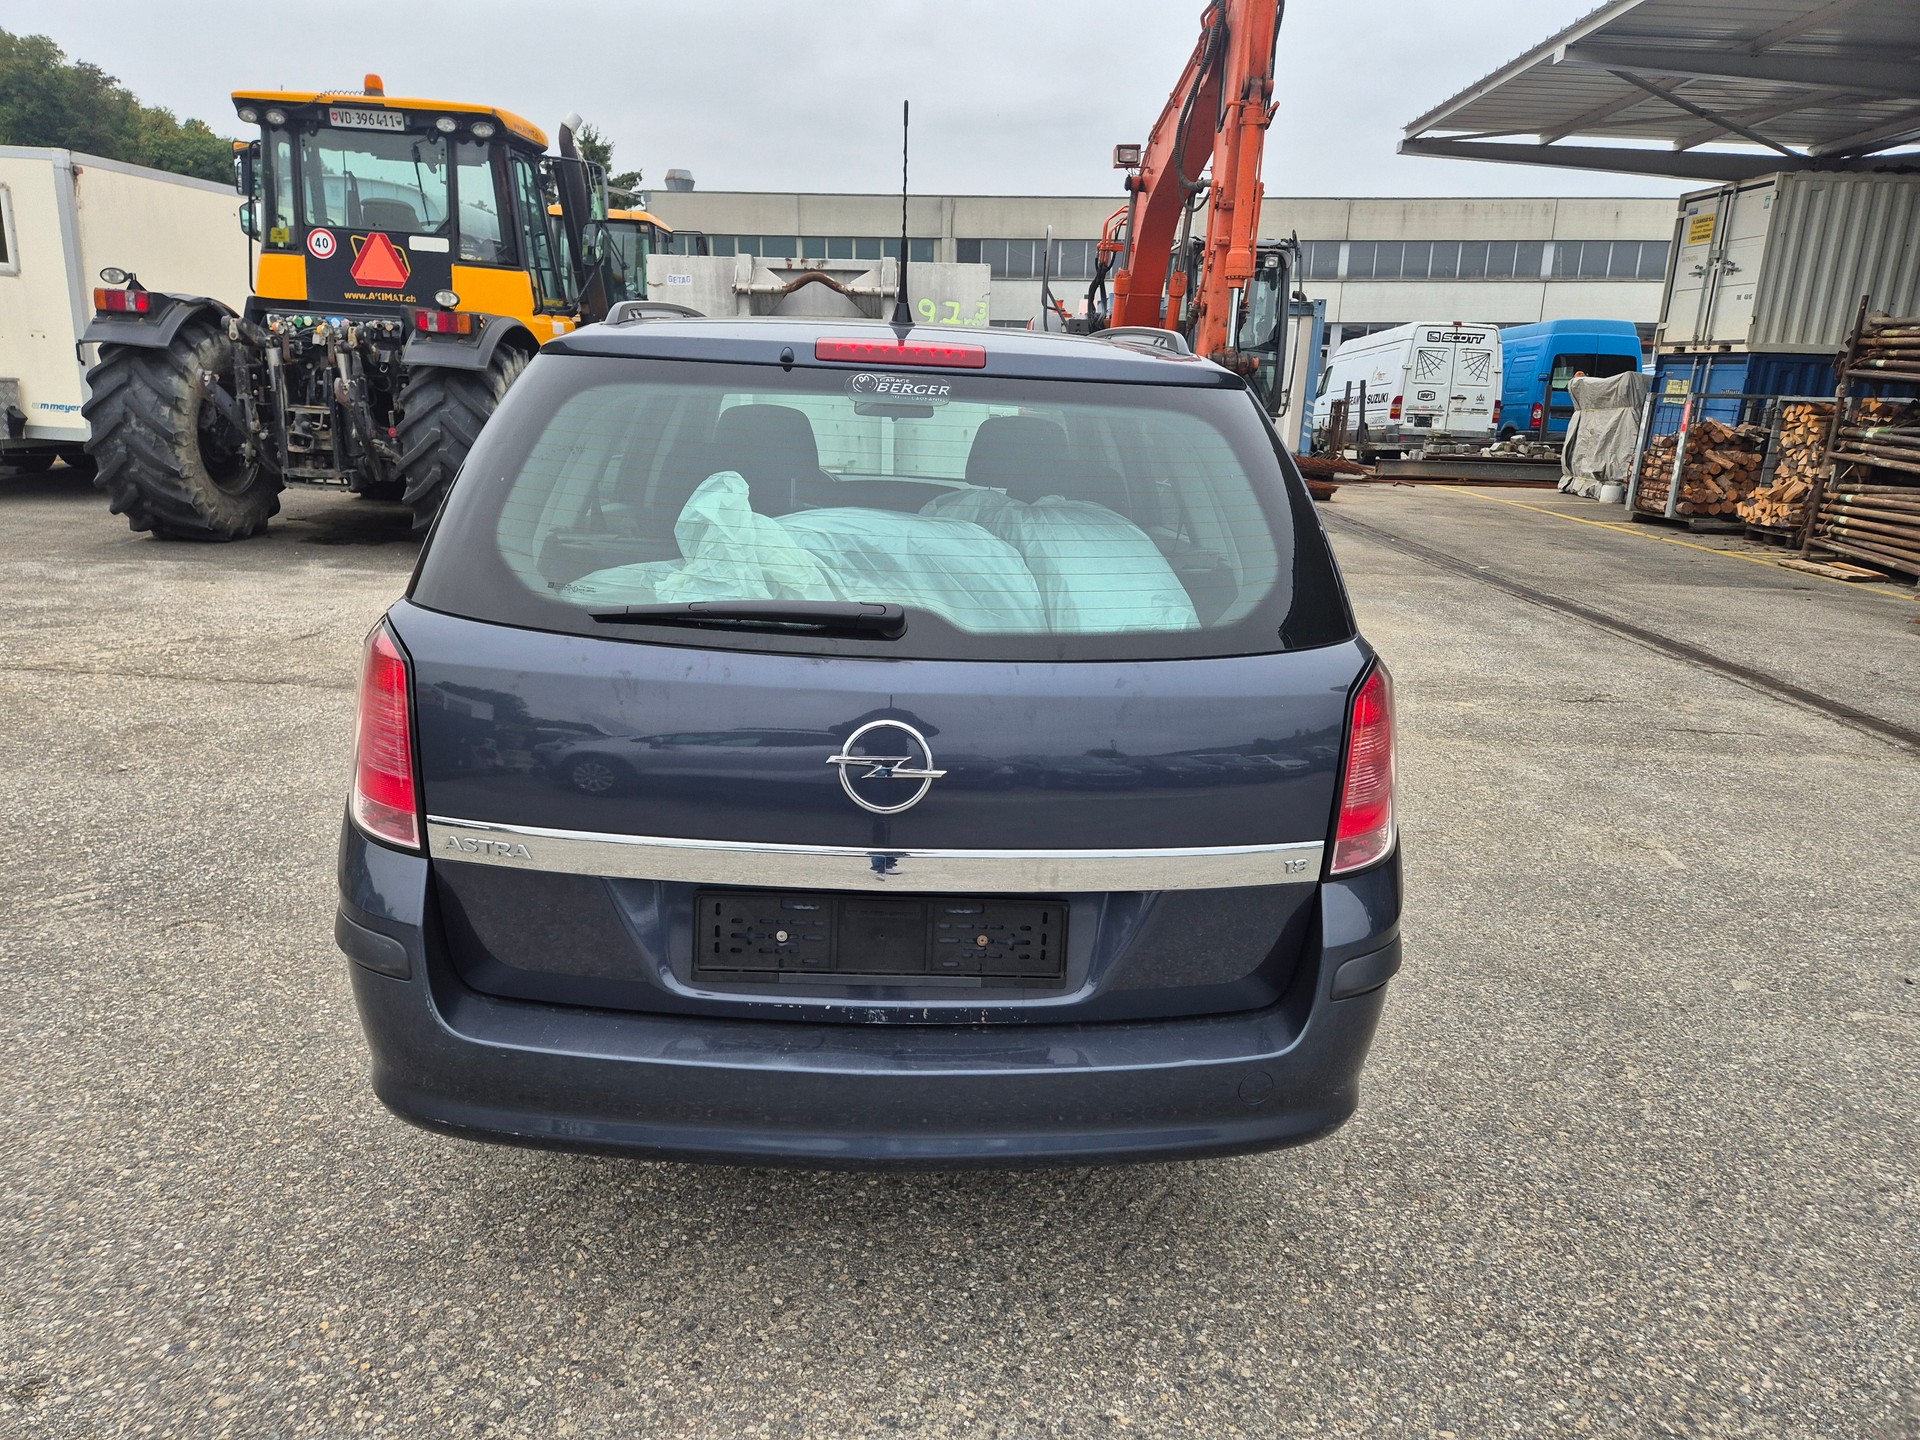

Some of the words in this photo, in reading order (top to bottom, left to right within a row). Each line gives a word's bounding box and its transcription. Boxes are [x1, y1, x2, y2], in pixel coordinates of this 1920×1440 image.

[315, 237, 328, 248] 40
[1441, 332, 1486, 344] SCOTT
[876, 382, 950, 395] BERGER
[1367, 392, 1389, 405] SUZUKI
[50, 403, 81, 413] meyer
[446, 835, 532, 859] ASTRA
